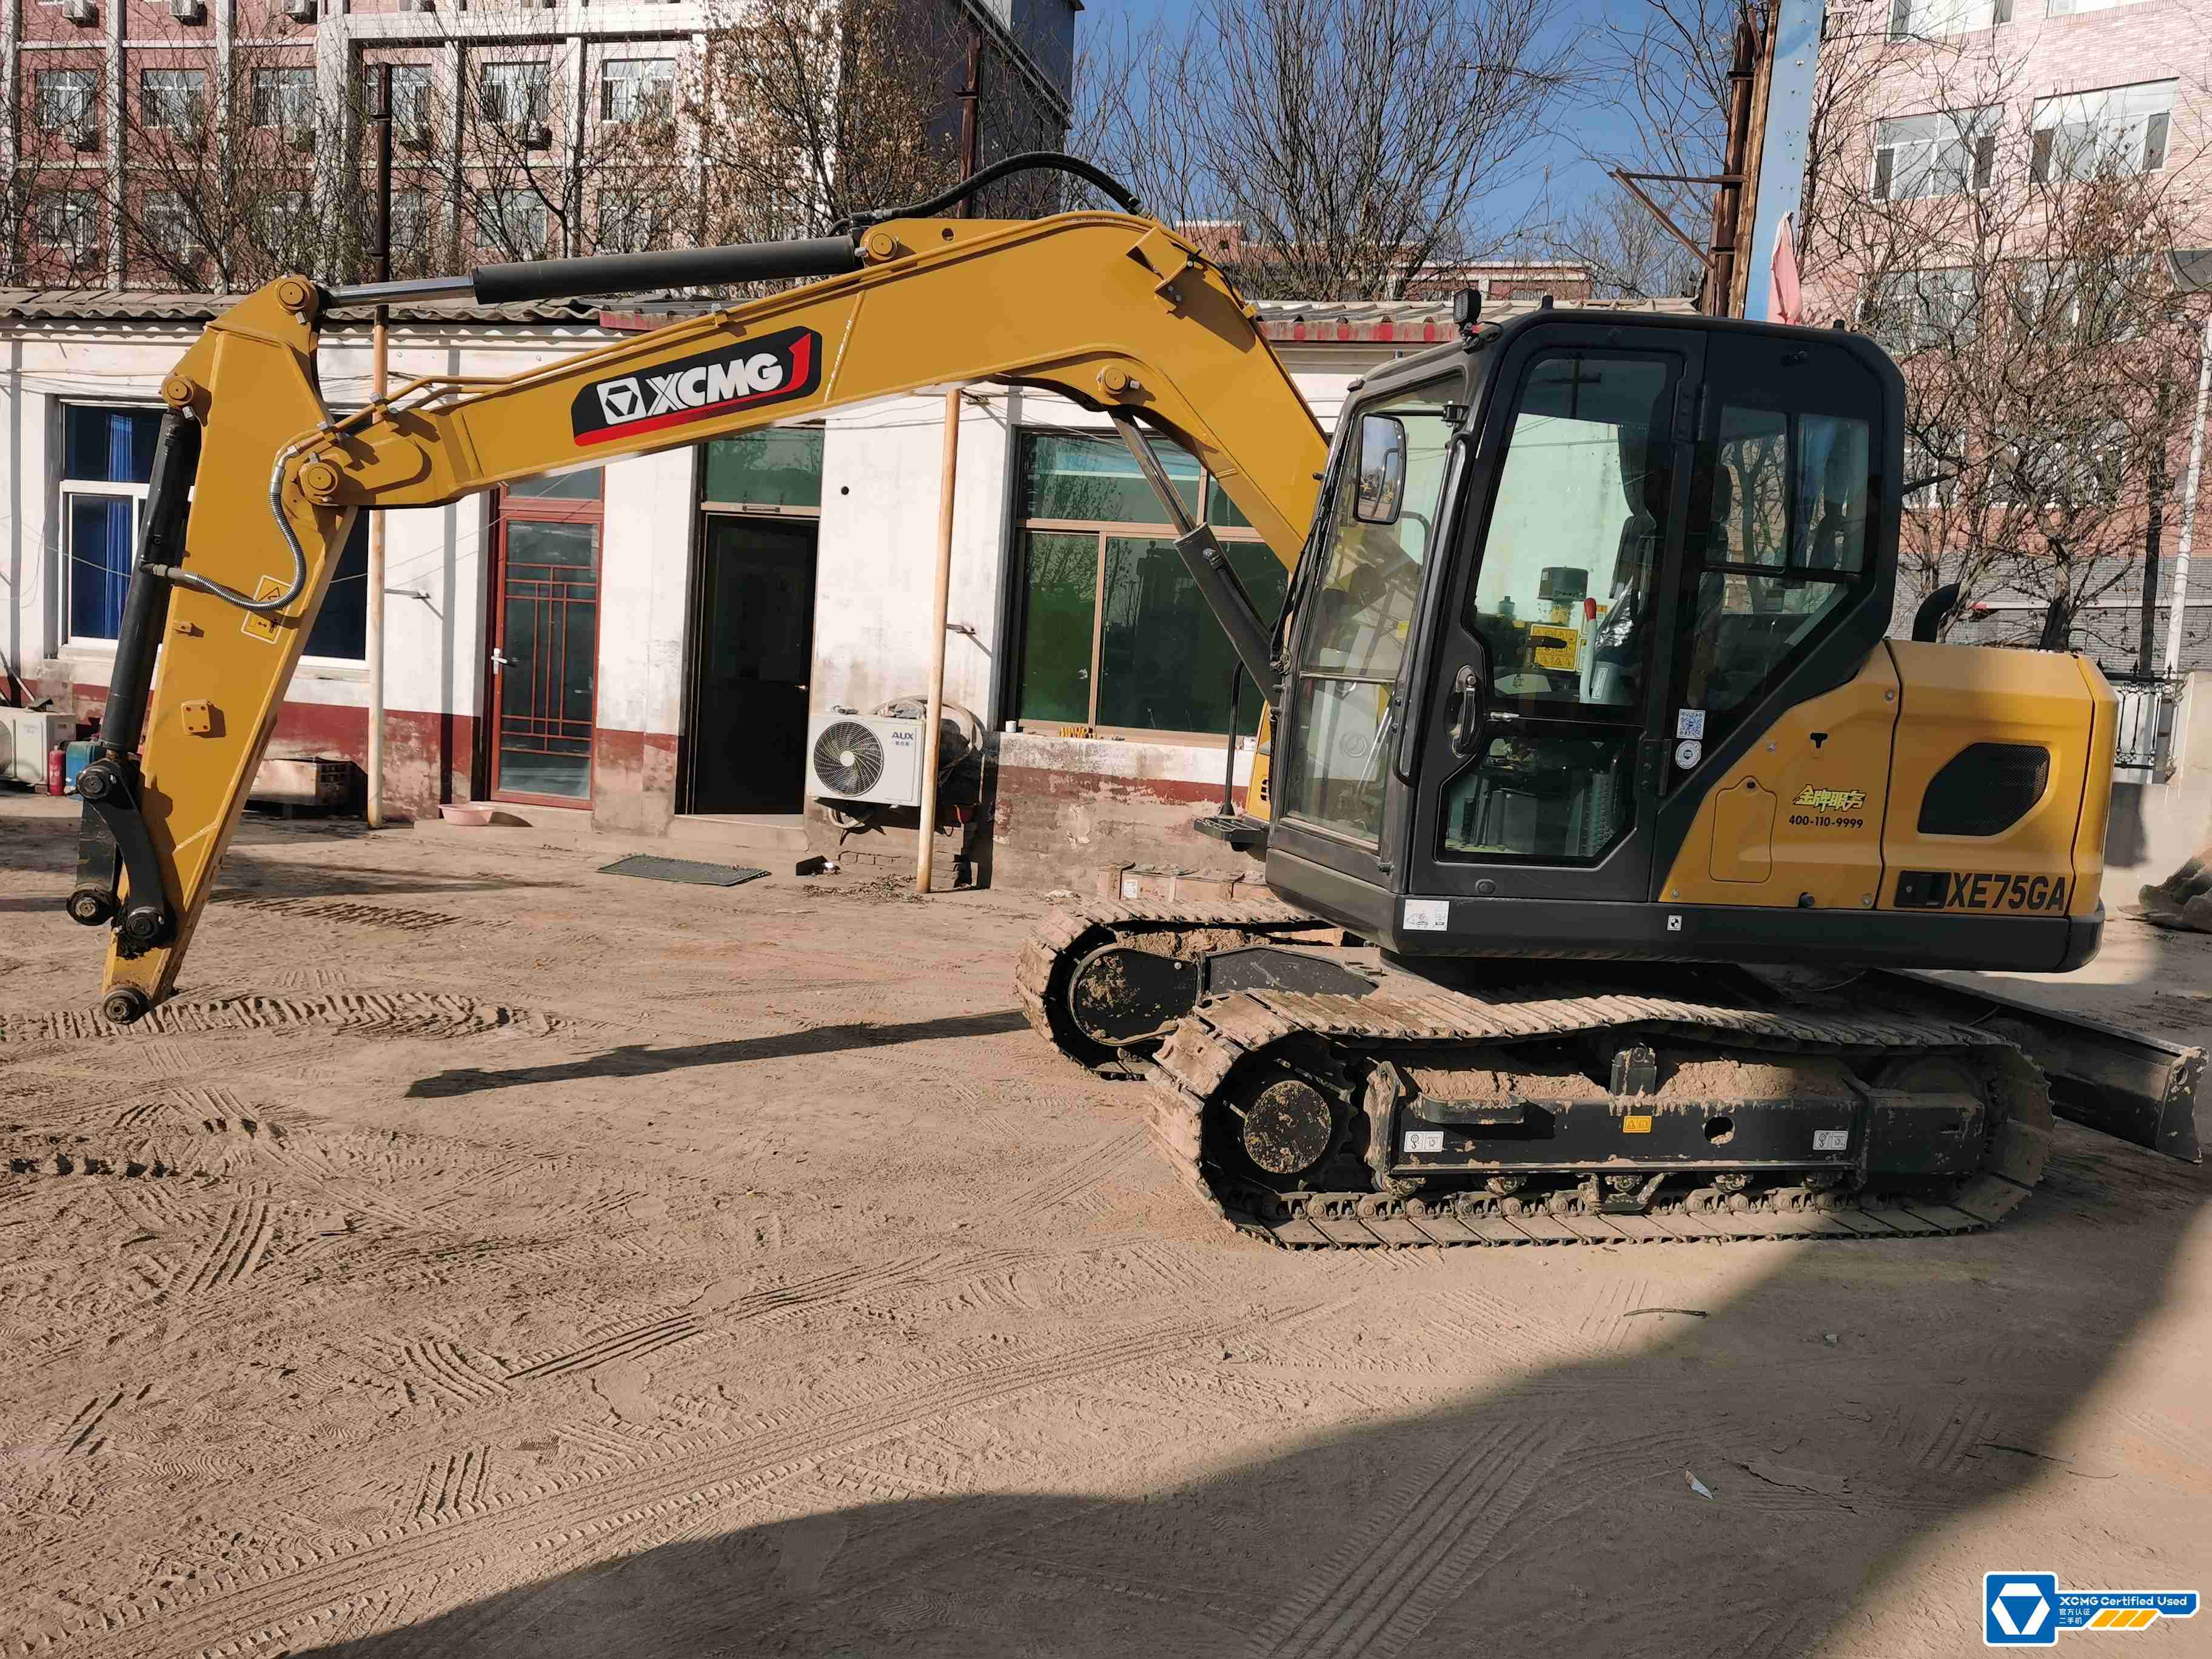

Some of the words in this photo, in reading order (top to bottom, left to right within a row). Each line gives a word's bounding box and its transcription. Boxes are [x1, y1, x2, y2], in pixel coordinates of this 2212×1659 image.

[645, 353, 783, 417] XCMG
[1792, 783, 1867, 813] 金牌服务
[1789, 815, 1863, 828] 400-110-9999
[1946, 872, 2066, 911] XE75GA
